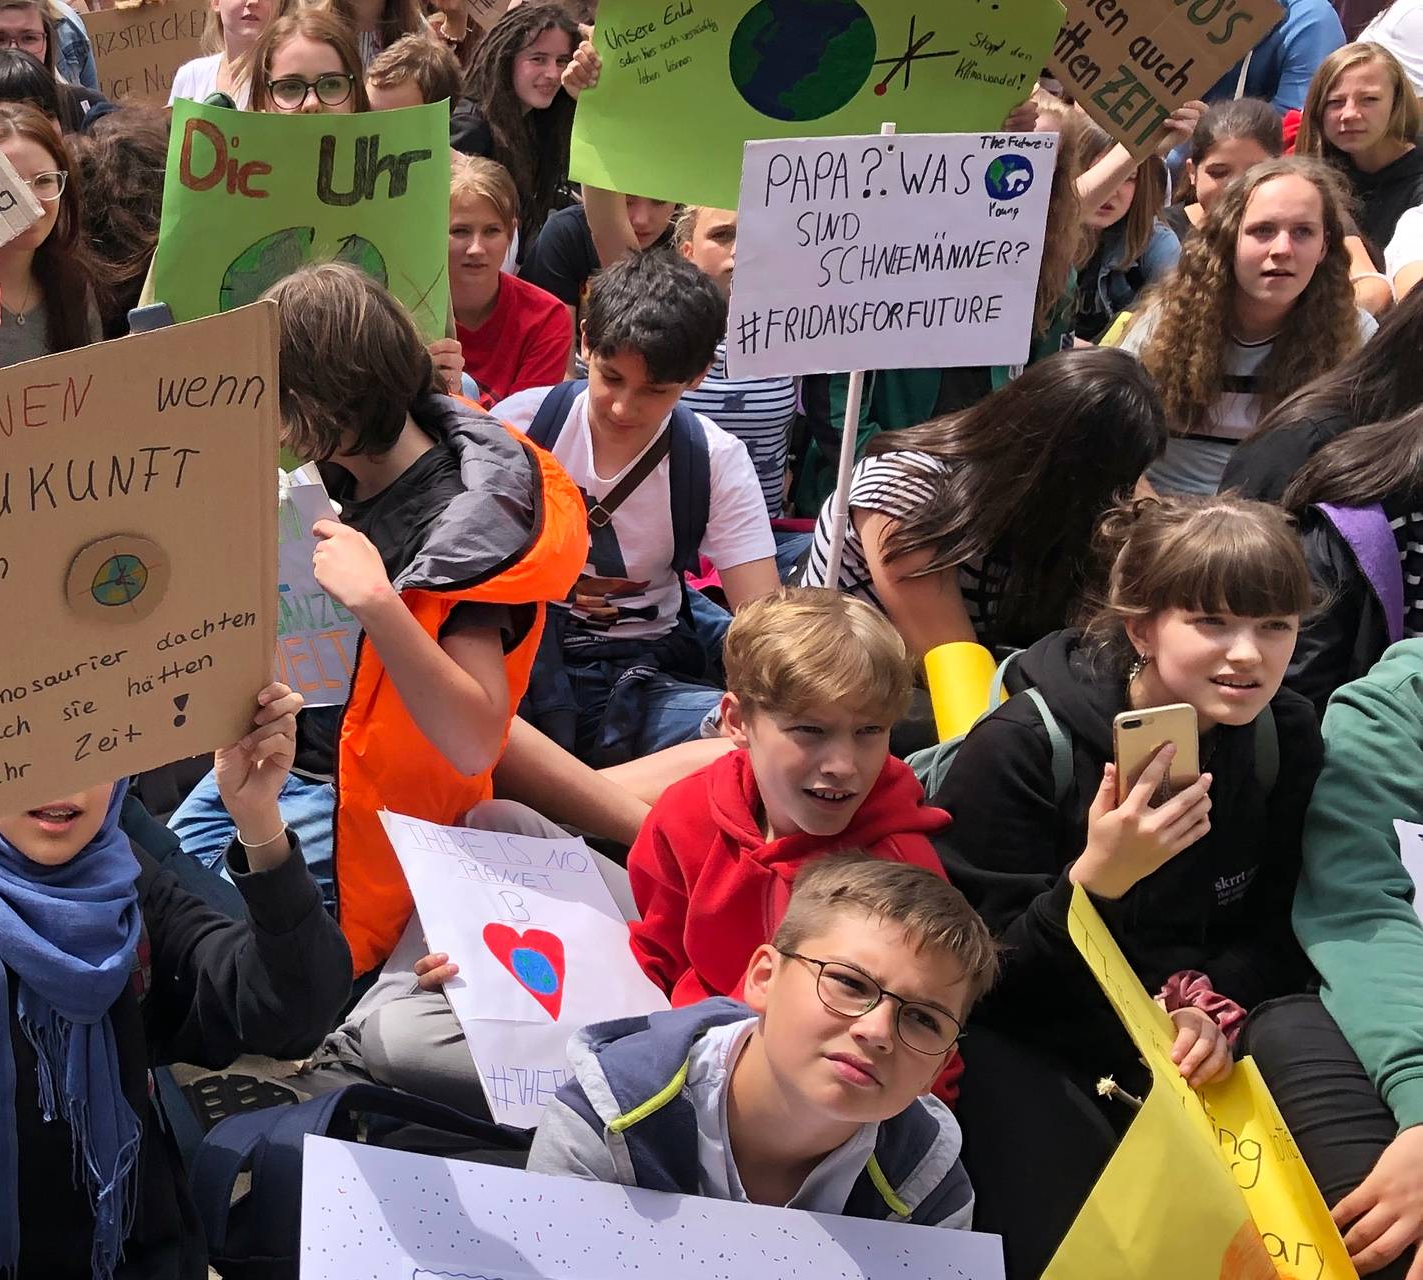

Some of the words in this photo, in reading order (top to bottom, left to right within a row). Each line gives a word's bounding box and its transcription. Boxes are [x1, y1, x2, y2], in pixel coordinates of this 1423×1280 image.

[93, 10, 207, 58] RZSTRECKE
[605, 22, 656, 50] Unsere
[1128, 36, 1195, 96] auch
[1092, 64, 1171, 146] ZEIT
[179, 117, 272, 198] Die
[316, 134, 432, 206] Uhr
[980, 136, 1005, 150] The
[1008, 136, 1041, 149] Future
[1044, 138, 1054, 149] is
[900, 150, 976, 195] WAS
[796, 211, 860, 247] SIND
[989, 202, 1019, 221] Young
[737, 295, 1003, 354] #FRIDAYSFORFUTURE
[157, 373, 266, 413] wenn
[156, 611, 256, 651] dachten
[277, 592, 355, 636] ANZE
[63, 700, 98, 721] sie
[127, 654, 213, 697] hätten
[74, 724, 142, 761] Zeit
[400, 821, 491, 860] THERE
[495, 835, 532, 865] IS
[546, 848, 589, 873] NO
[458, 859, 555, 890] PLANET
[498, 890, 531, 922] B
[486, 1064, 568, 1111] #THEF
